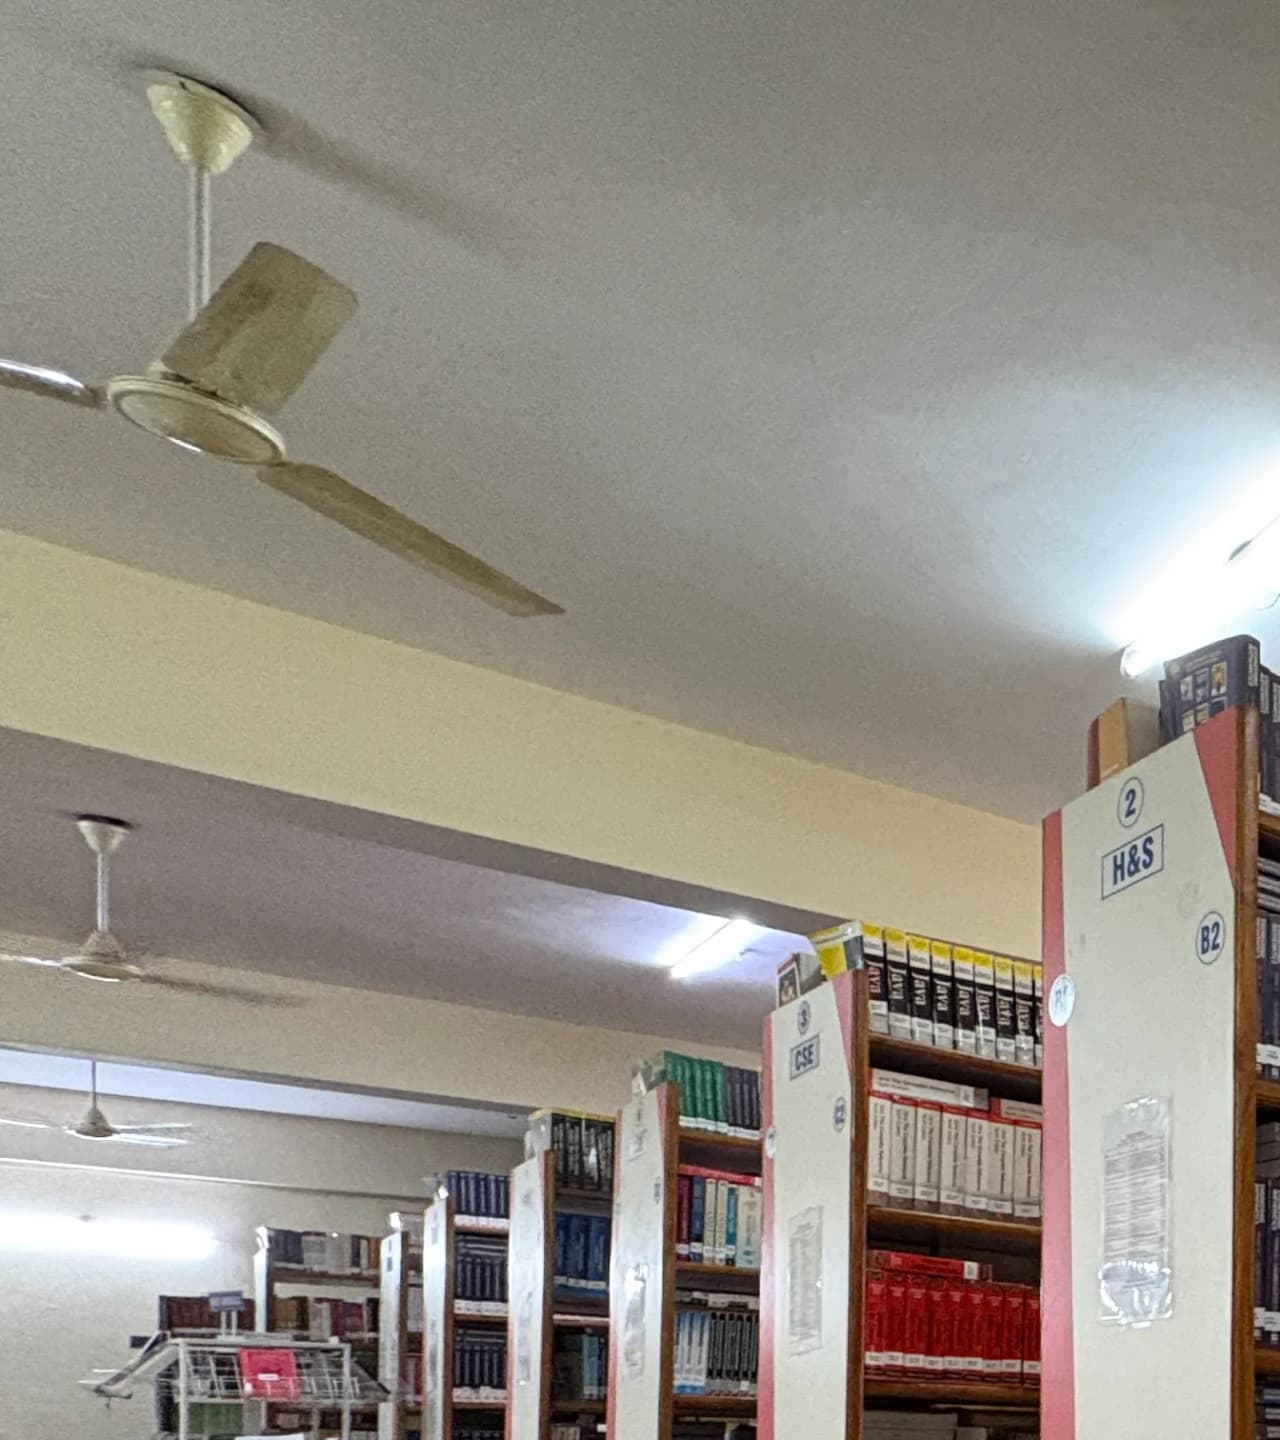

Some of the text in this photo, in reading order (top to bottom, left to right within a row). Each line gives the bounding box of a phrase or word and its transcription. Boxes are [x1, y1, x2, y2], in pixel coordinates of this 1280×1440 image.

[1124, 788, 1136, 818] 2
[1112, 835, 1154, 885] H&S
[1200, 922, 1221, 954] B2
[889, 965, 906, 1000] Java
[911, 973, 929, 1006] Java
[934, 979, 951, 1011] Java
[956, 984, 973, 1016] Java
[997, 995, 1013, 1026] Java
[795, 1044, 814, 1071] CSE
